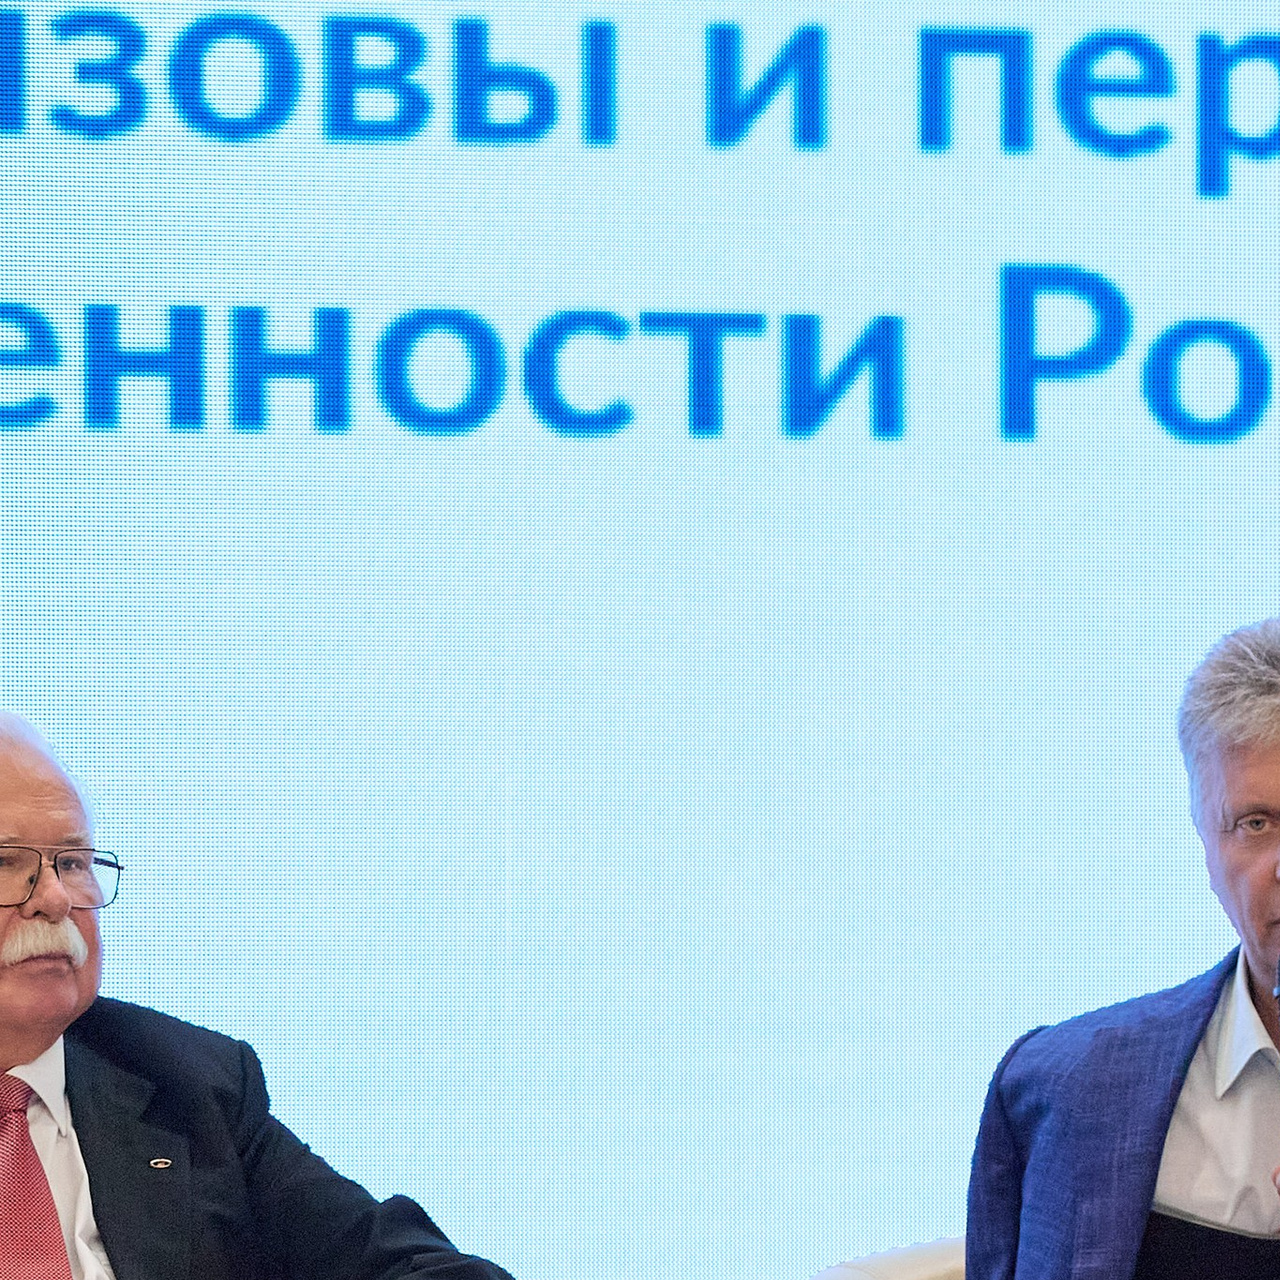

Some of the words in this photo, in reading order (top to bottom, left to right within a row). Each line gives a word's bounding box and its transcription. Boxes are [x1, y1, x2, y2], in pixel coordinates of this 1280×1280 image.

[704, 22, 827, 150] и
[918, 27, 1280, 200] пер
[999, 262, 1272, 445] Ро
